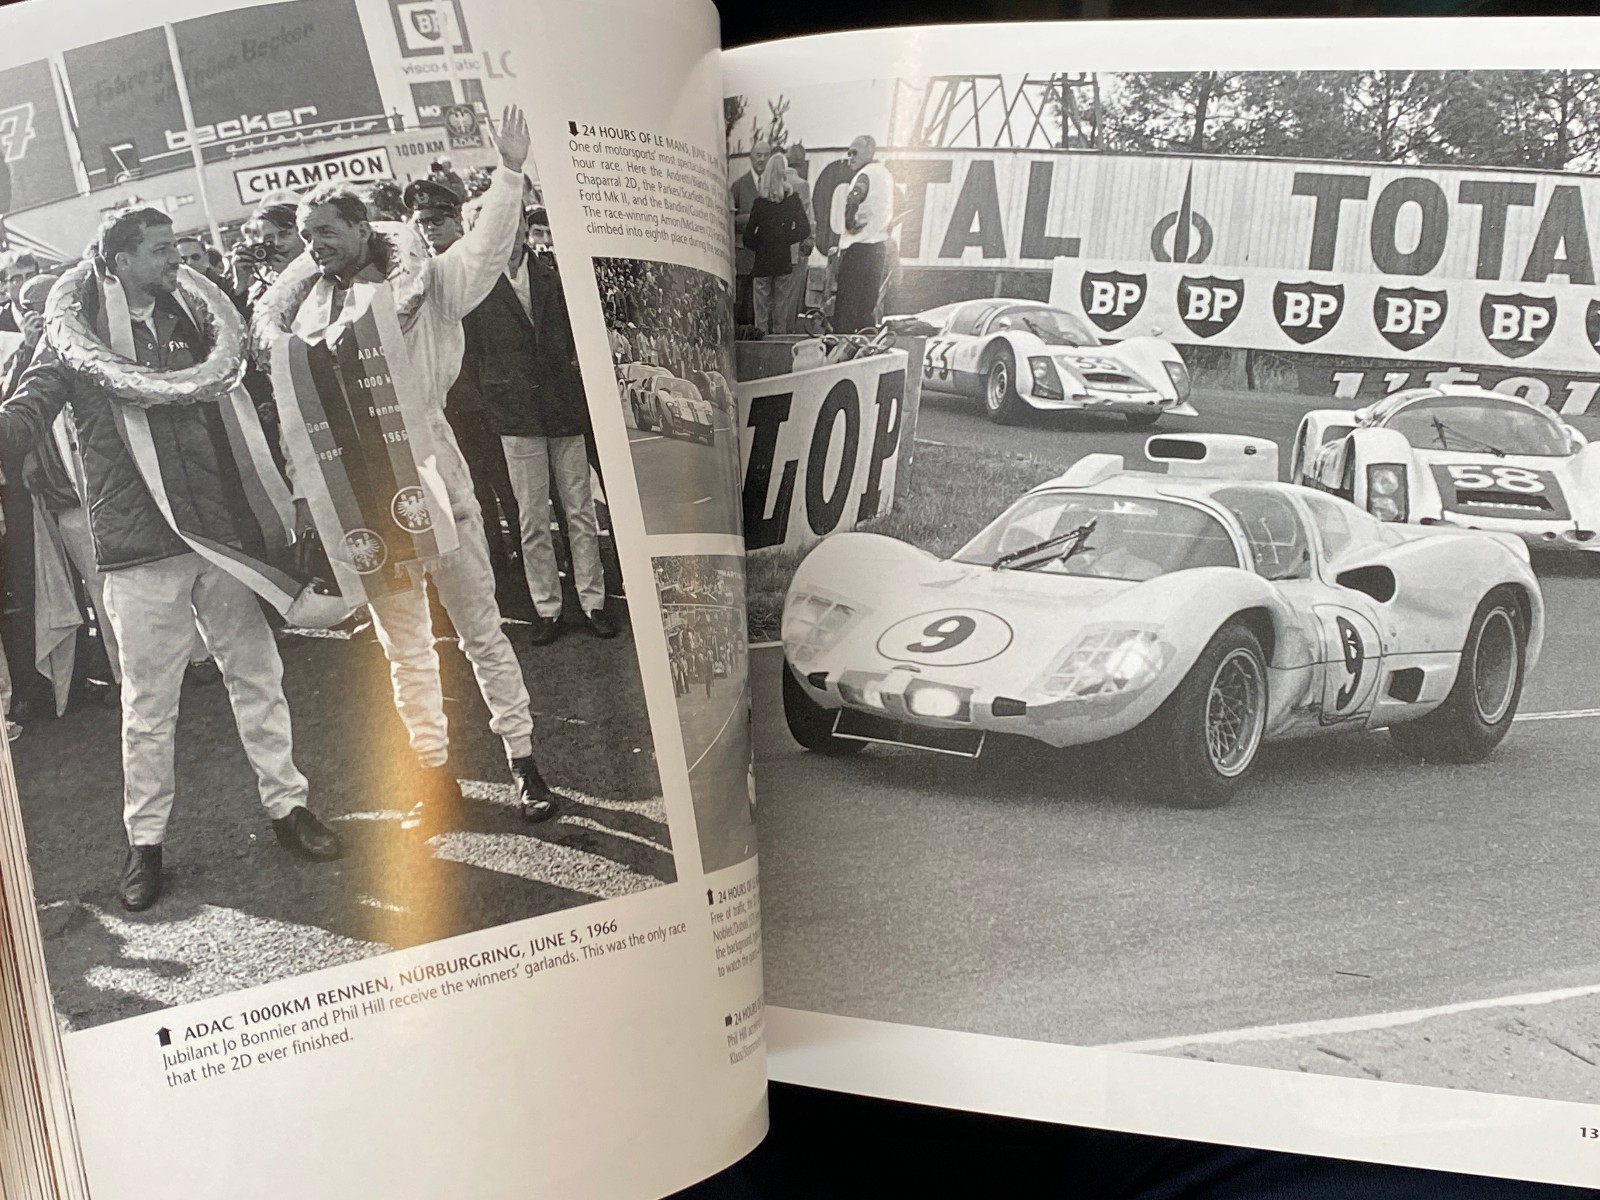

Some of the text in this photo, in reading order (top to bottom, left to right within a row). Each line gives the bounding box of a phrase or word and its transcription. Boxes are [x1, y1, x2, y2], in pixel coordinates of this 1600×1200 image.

[164, 105, 317, 150] becker
[582, 125, 595, 136] 24
[599, 126, 636, 141] HOURS
[639, 132, 652, 143] OF
[654, 135, 664, 147] LE
[569, 140, 590, 152] One
[593, 142, 602, 153] of
[659, 152, 675, 165] most
[250, 156, 384, 192] CHAMPION
[572, 156, 595, 168] hour
[601, 160, 622, 171] race.
[627, 162, 646, 174] Here
[650, 165, 662, 177] the
[576, 173, 621, 188] Chaparral
[626, 177, 640, 191] 2D,
[643, 180, 655, 192] the
[579, 189, 601, 201] Ford
[604, 191, 618, 203] Mk
[632, 195, 647, 206] and
[650, 197, 662, 208] the
[583, 206, 601, 217] The
[604, 207, 658, 226] race-winning
[587, 222, 623, 235] climbed
[626, 225, 642, 236] into
[645, 228, 669, 242] eighth
[671, 232, 688, 244] place
[1089, 281, 1141, 317] BP
[1184, 286, 1237, 322] BP
[1281, 292, 1338, 328] BP
[1382, 297, 1441, 335] BP
[1488, 304, 1550, 342] BP
[358, 375, 383, 389] 1000
[306, 421, 329, 433] Dem
[382, 430, 408, 444] 1966
[1447, 465, 1544, 492] 58
[906, 616, 976, 653] 9
[718, 891, 726, 904] 24
[711, 911, 723, 925] Free
[726, 907, 731, 919] of
[715, 946, 726, 960] the
[718, 965, 725, 977] to
[726, 957, 742, 972] watch
[185, 919, 618, 1041] ADAC 1000KM RENNEN, NÜRBURGRING, JUNE 5, 1966
[162, 1042, 219, 1070] Jubilant
[222, 1036, 236, 1056] Jo
[240, 1023, 296, 1047] Bonnier
[301, 1013, 328, 1033] and
[332, 1005, 358, 1025] Phil
[363, 998, 385, 1016] Hill
[390, 986, 438, 1009] receive
[441, 980, 463, 996] the
[525, 952, 579, 979] garlands.
[582, 945, 604, 960] This
[606, 940, 627, 952] was
[629, 934, 645, 947] the
[647, 927, 666, 944] only
[669, 922, 686, 937] race
[734, 1012, 742, 1025] 24
[167, 1028, 353, 1088] that the 2D ever finished.
